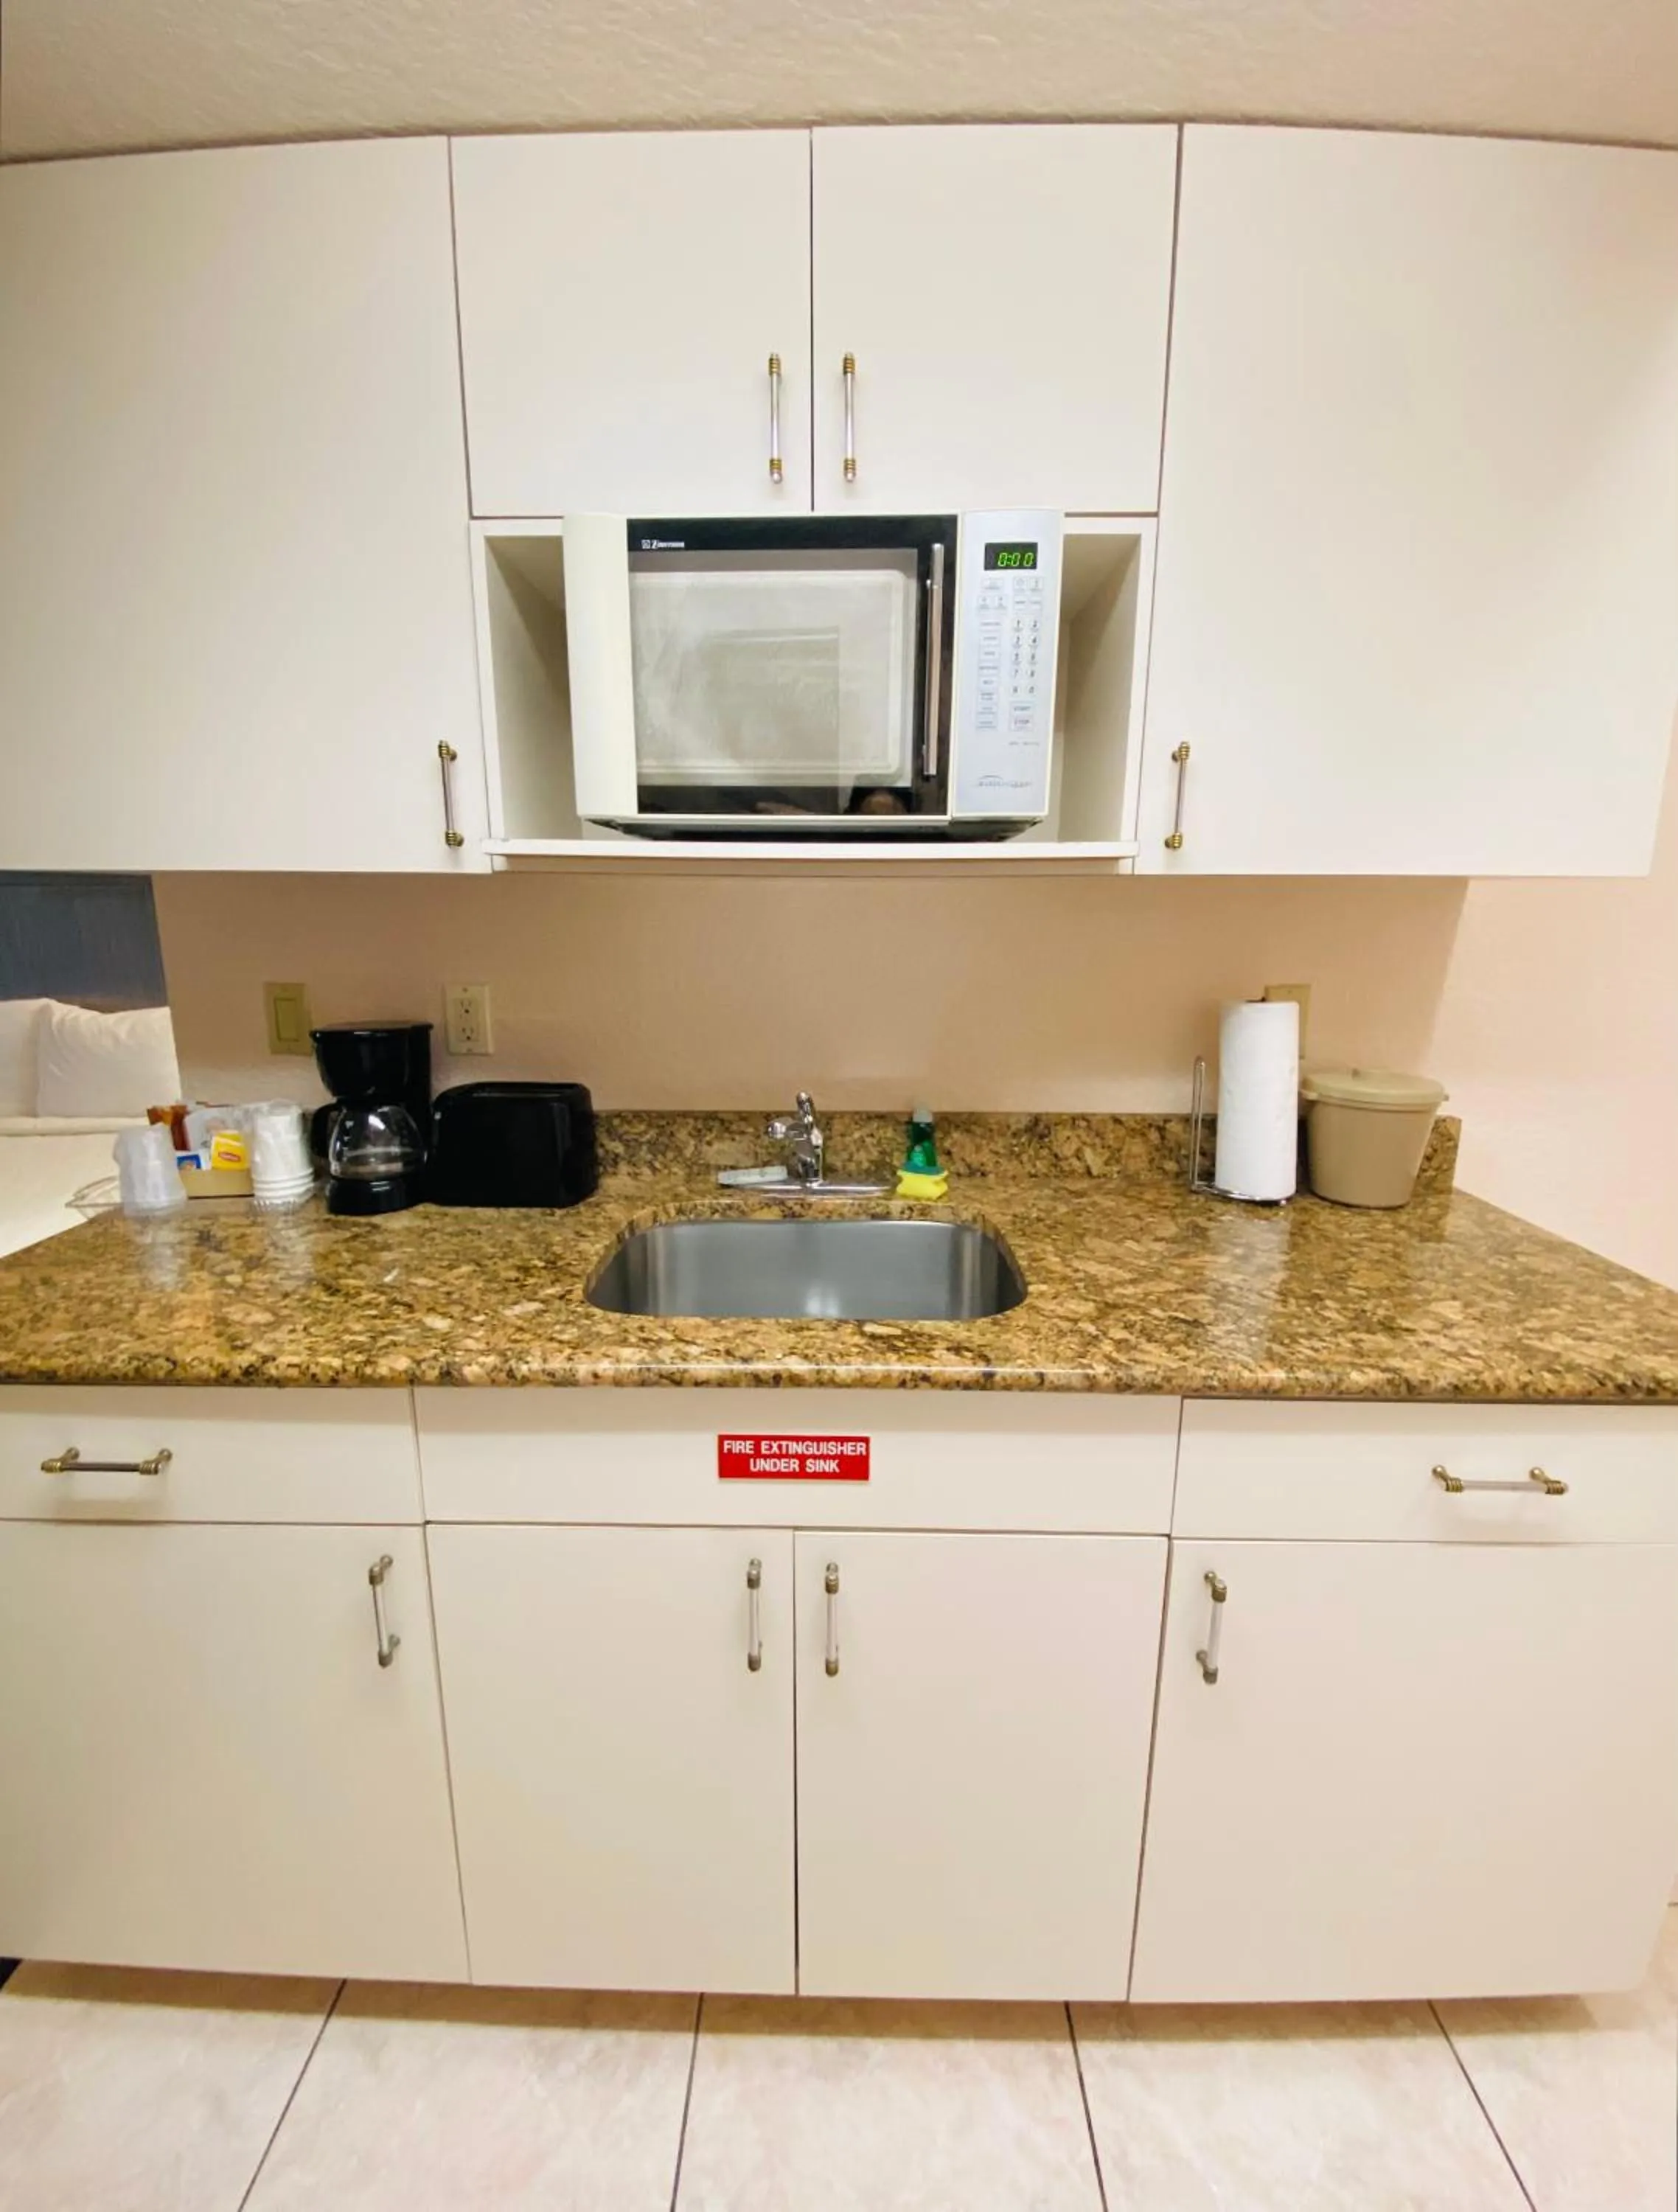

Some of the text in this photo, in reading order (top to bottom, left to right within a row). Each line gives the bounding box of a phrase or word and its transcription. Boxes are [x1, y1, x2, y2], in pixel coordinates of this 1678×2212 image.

[998, 552, 1034, 567] 0:00
[723, 1440, 866, 1455] FIRE EXTINGUISHER
[750, 1458, 840, 1473] UNDER SINK
